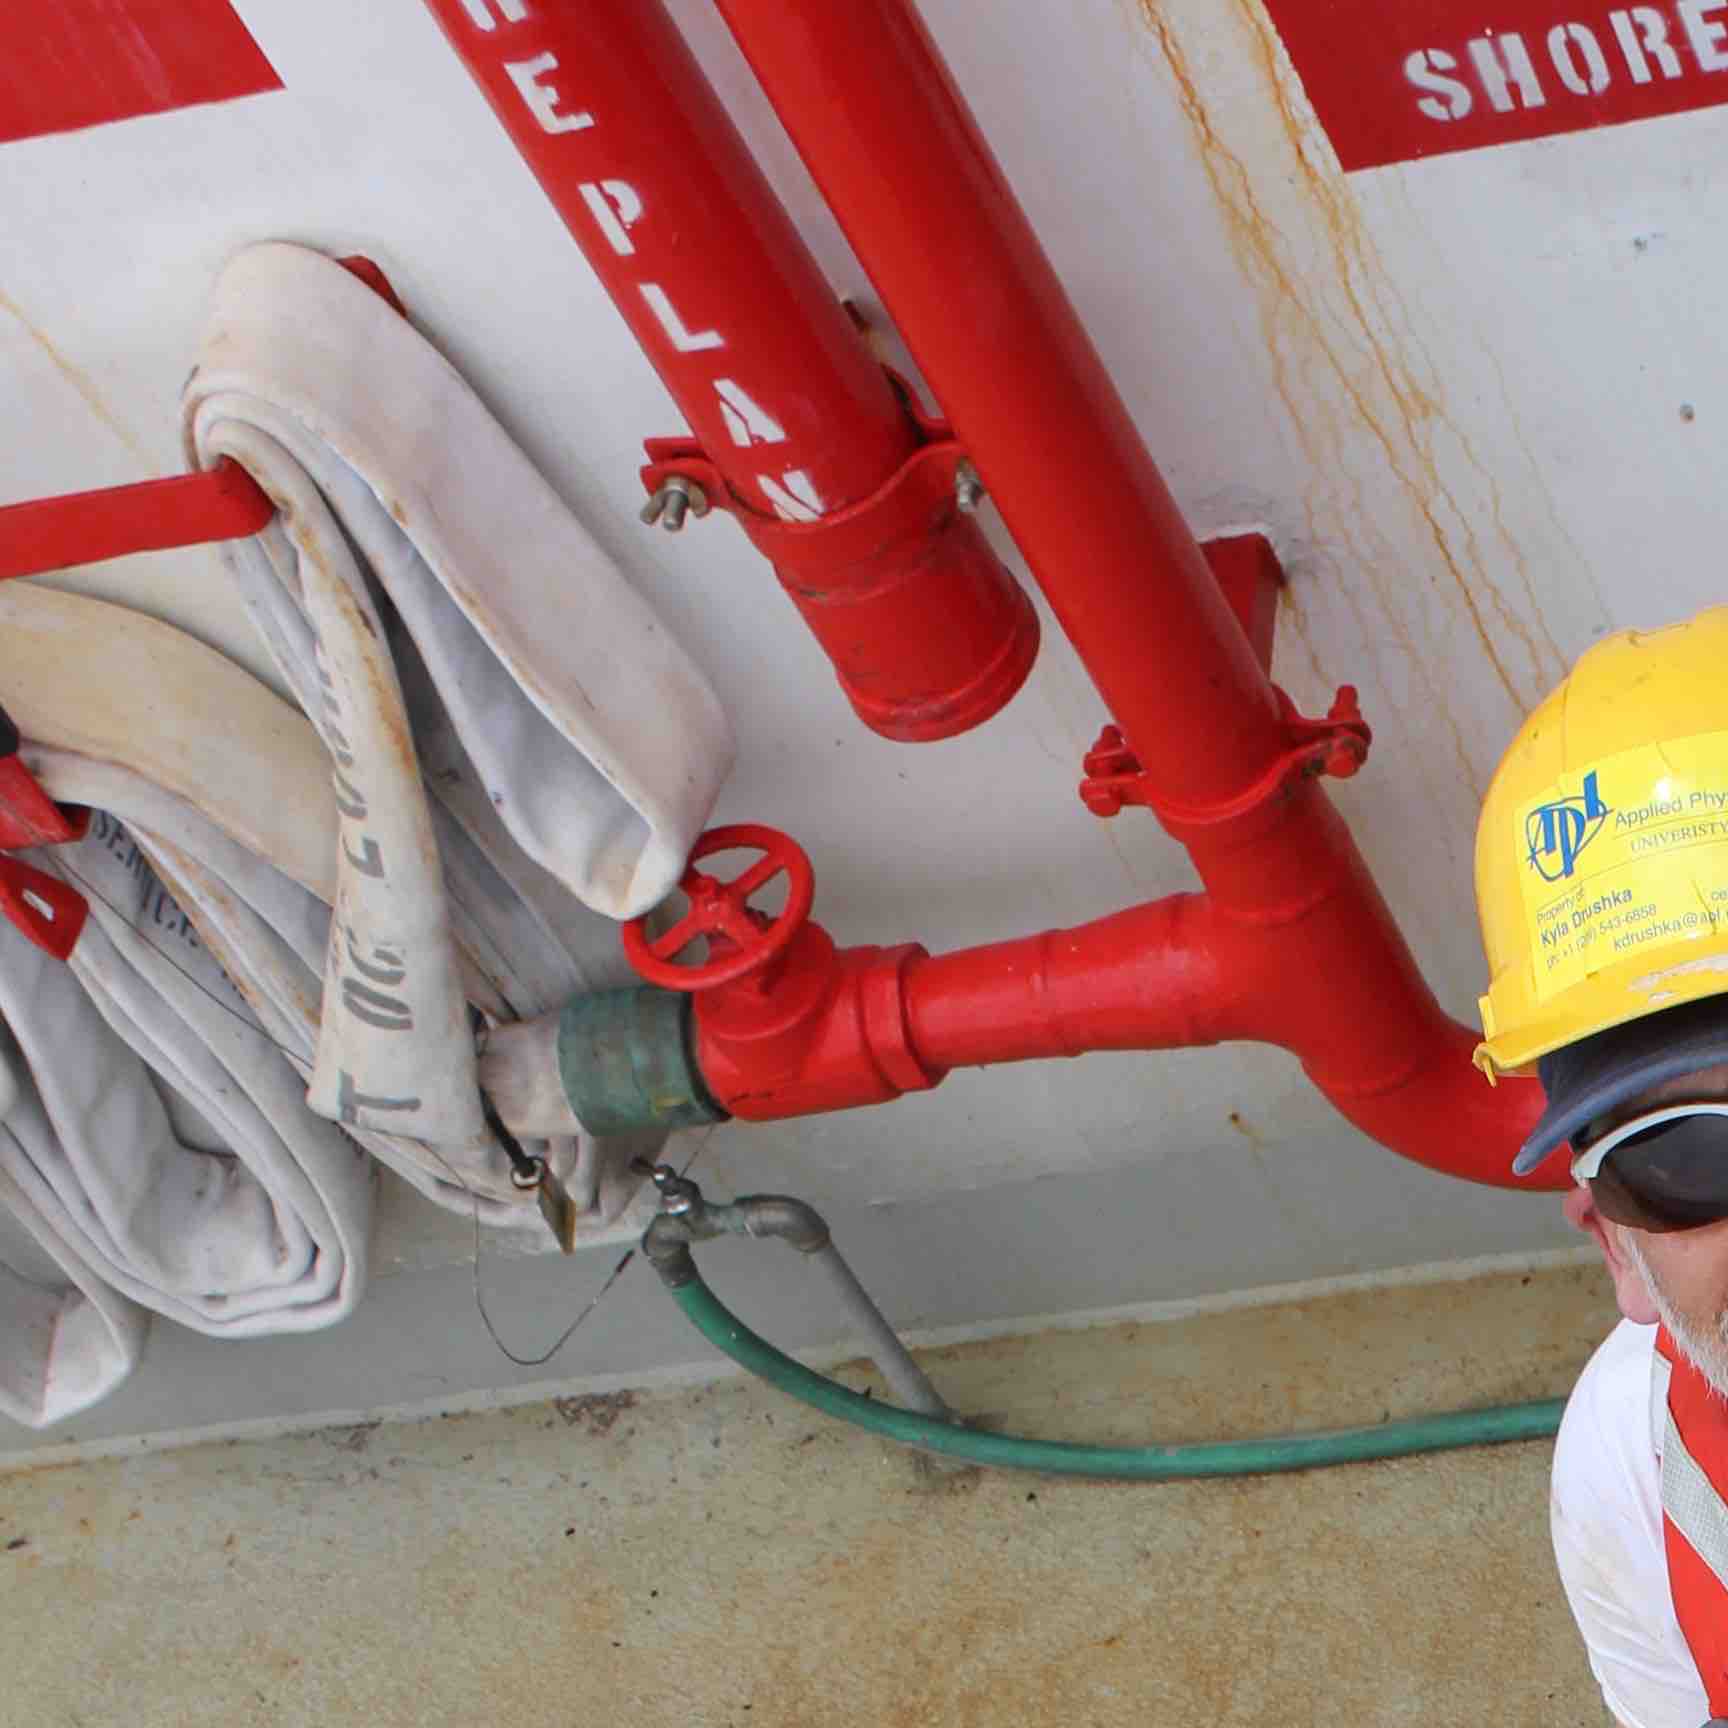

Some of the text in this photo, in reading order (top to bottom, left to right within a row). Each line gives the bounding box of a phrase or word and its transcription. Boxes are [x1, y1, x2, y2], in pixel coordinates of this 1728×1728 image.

[577, 179, 826, 522] PLAN
[1614, 796, 1683, 830] Applied
[1540, 886, 1633, 949] Kyla Drushka
